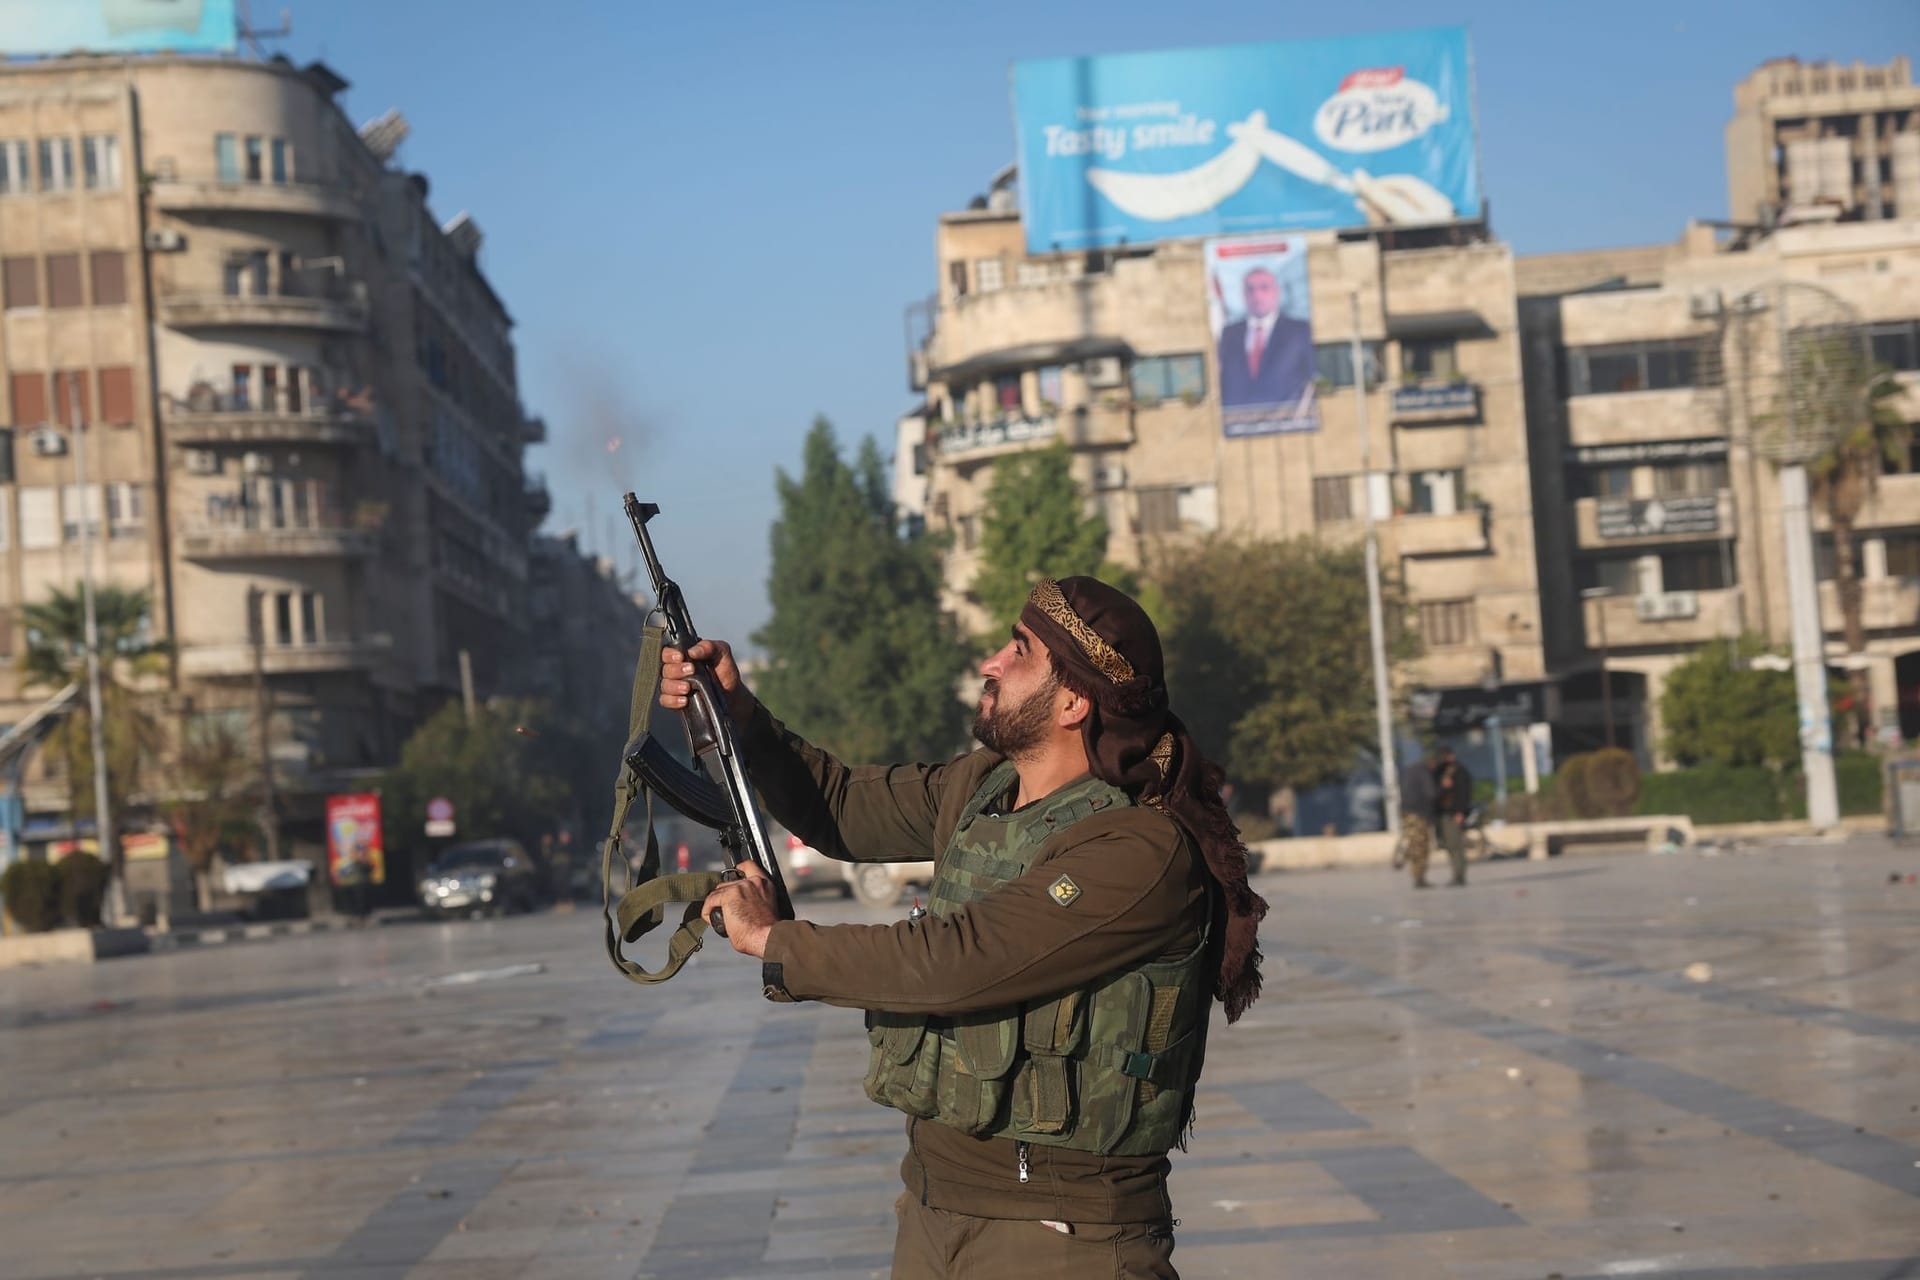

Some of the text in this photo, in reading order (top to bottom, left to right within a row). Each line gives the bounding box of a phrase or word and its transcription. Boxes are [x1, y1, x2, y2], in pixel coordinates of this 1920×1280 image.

[1043, 113, 1216, 160] Tasty smile
[1328, 98, 1418, 138] Park
